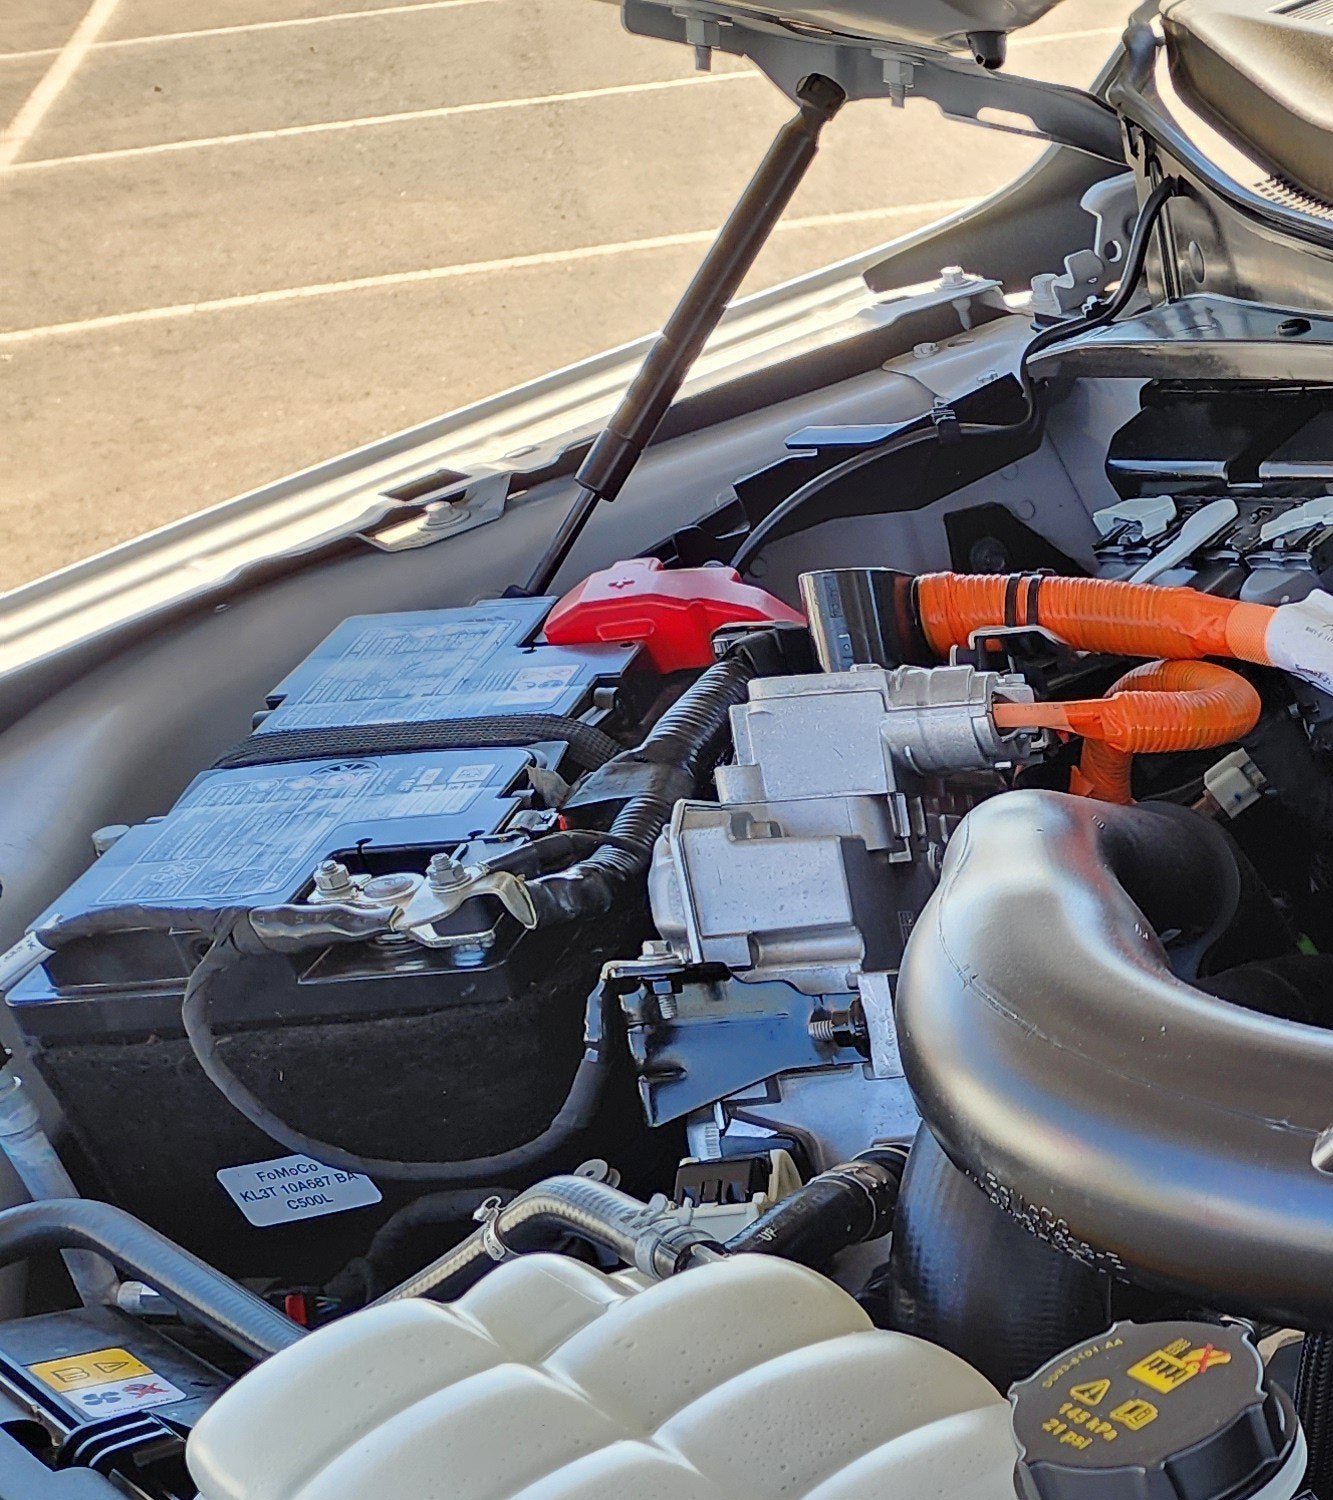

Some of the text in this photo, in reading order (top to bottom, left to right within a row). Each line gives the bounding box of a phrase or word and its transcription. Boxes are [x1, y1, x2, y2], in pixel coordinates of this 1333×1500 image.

[256, 1163, 318, 1182] FoMoCo
[239, 1186, 278, 1202] KL3T
[281, 1176, 330, 1195] 10A687
[287, 1193, 333, 1210] C500L
[1085, 1416, 1118, 1441] kPa
[1060, 1431, 1093, 1450] psi
